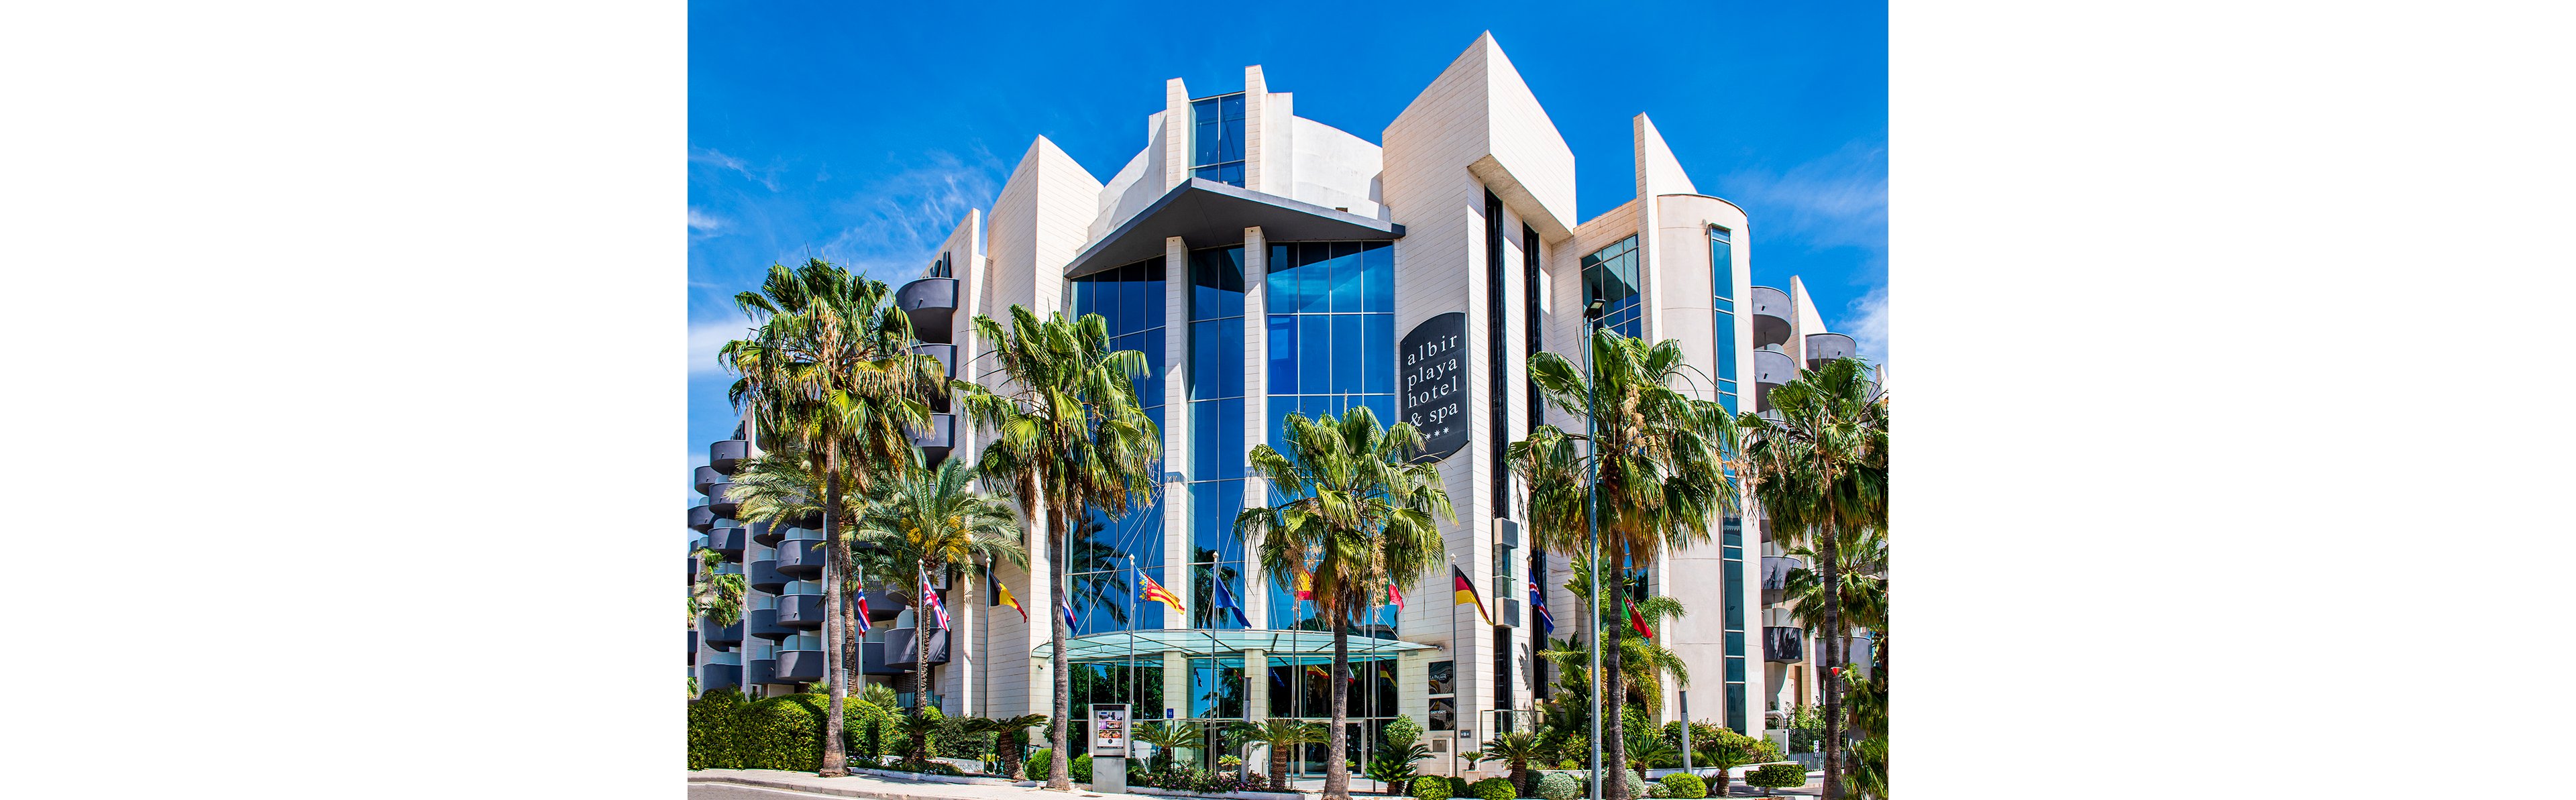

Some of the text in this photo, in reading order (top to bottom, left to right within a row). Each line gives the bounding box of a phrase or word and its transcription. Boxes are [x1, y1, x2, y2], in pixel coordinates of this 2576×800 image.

[1407, 335, 1457, 365] albir
[1407, 359, 1458, 392] playa
[1407, 376, 1458, 408] hotel
[1409, 403, 1458, 427] & spa
